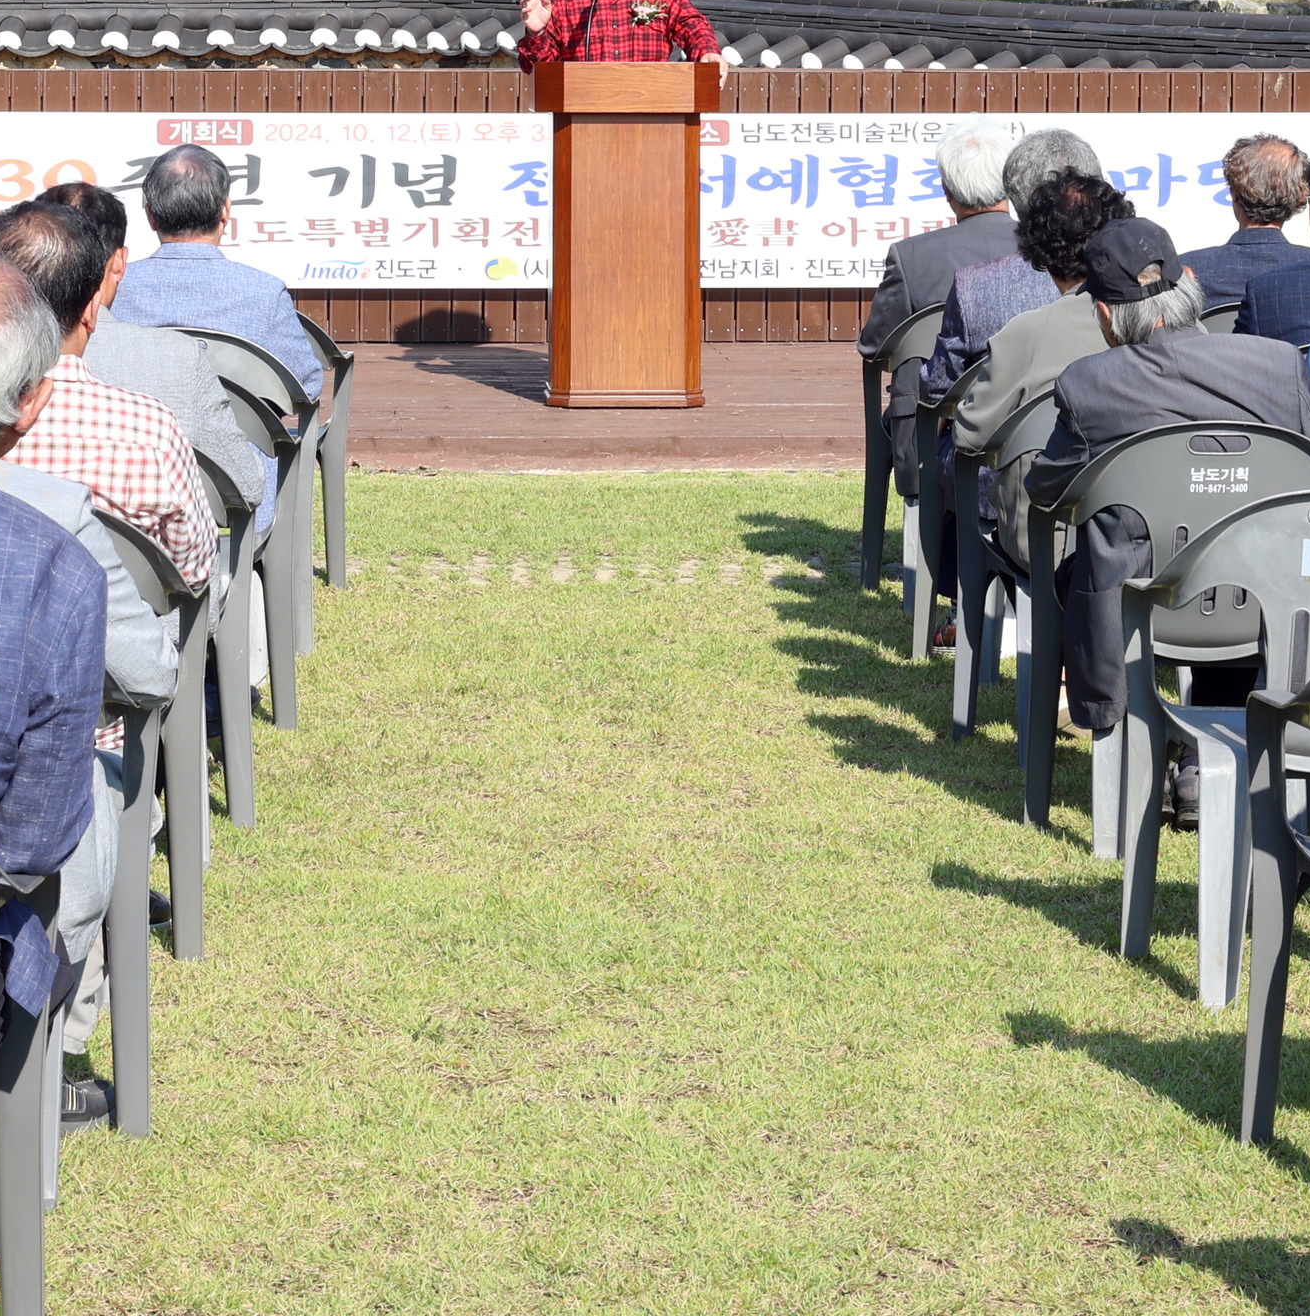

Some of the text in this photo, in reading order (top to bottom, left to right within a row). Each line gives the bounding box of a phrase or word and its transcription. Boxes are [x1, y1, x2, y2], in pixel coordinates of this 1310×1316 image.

[168, 120, 244, 145] 개회식
[264, 123, 331, 143] 2024.
[341, 123, 375, 143] 10.
[386, 121, 462, 145] 12.(토)
[471, 121, 522, 144] 오후
[740, 120, 1027, 145] 남도전통미술관(운)
[307, 153, 458, 209] 기념
[297, 262, 359, 281] Jindo
[374, 258, 438, 280] 진도군
[805, 258, 887, 280] 진도지부
[1190, 466, 1250, 483] 남도기획
[1189, 482, 1249, 494] 010-8471-3400
